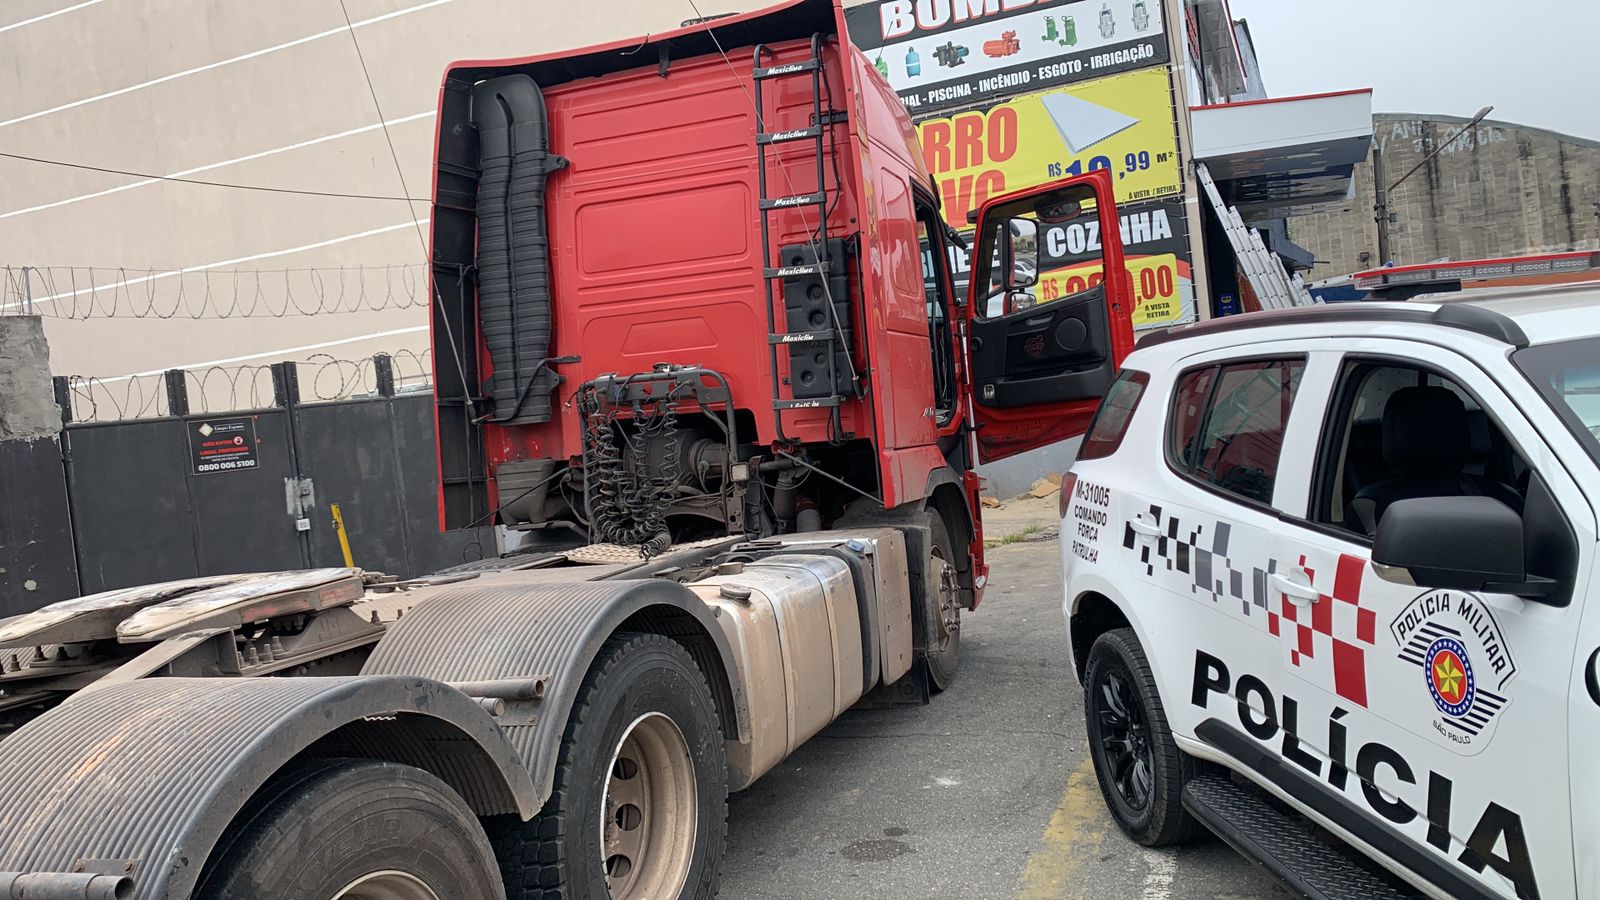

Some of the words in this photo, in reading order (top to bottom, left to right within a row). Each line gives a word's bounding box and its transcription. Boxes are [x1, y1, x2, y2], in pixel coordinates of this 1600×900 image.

[880, 0, 1053, 39] BOM
[928, 84, 972, 103] PISCINA
[979, 70, 1030, 93] INCÊNDIO
[1038, 58, 1082, 80] ESGOTO
[1090, 43, 1154, 70] IRRIGAÇÃO
[1048, 161, 1062, 178] R$
[937, 169, 1005, 228] VC
[1133, 189, 1151, 199] VISTA
[1046, 208, 1173, 258] COZNHA
[1042, 276, 1059, 300] R$
[1146, 310, 1170, 319] RETIRA
[1151, 302, 1170, 310] VISTA
[198, 463, 220, 472] 0800
[220, 461, 236, 469] 006
[236, 459, 255, 468] 5100
[1075, 479, 1110, 507] M-31005
[1074, 505, 1107, 526] COMANDO
[1078, 522, 1099, 543] FORÇA
[1072, 540, 1099, 565] PATRULHA
[1397, 593, 1450, 641] POLÍCIA
[1457, 598, 1507, 675] MILITAR
[1432, 719, 1447, 737] SÃO
[1447, 731, 1471, 745] PAULO
[1190, 649, 1543, 900] POLÍCIA
